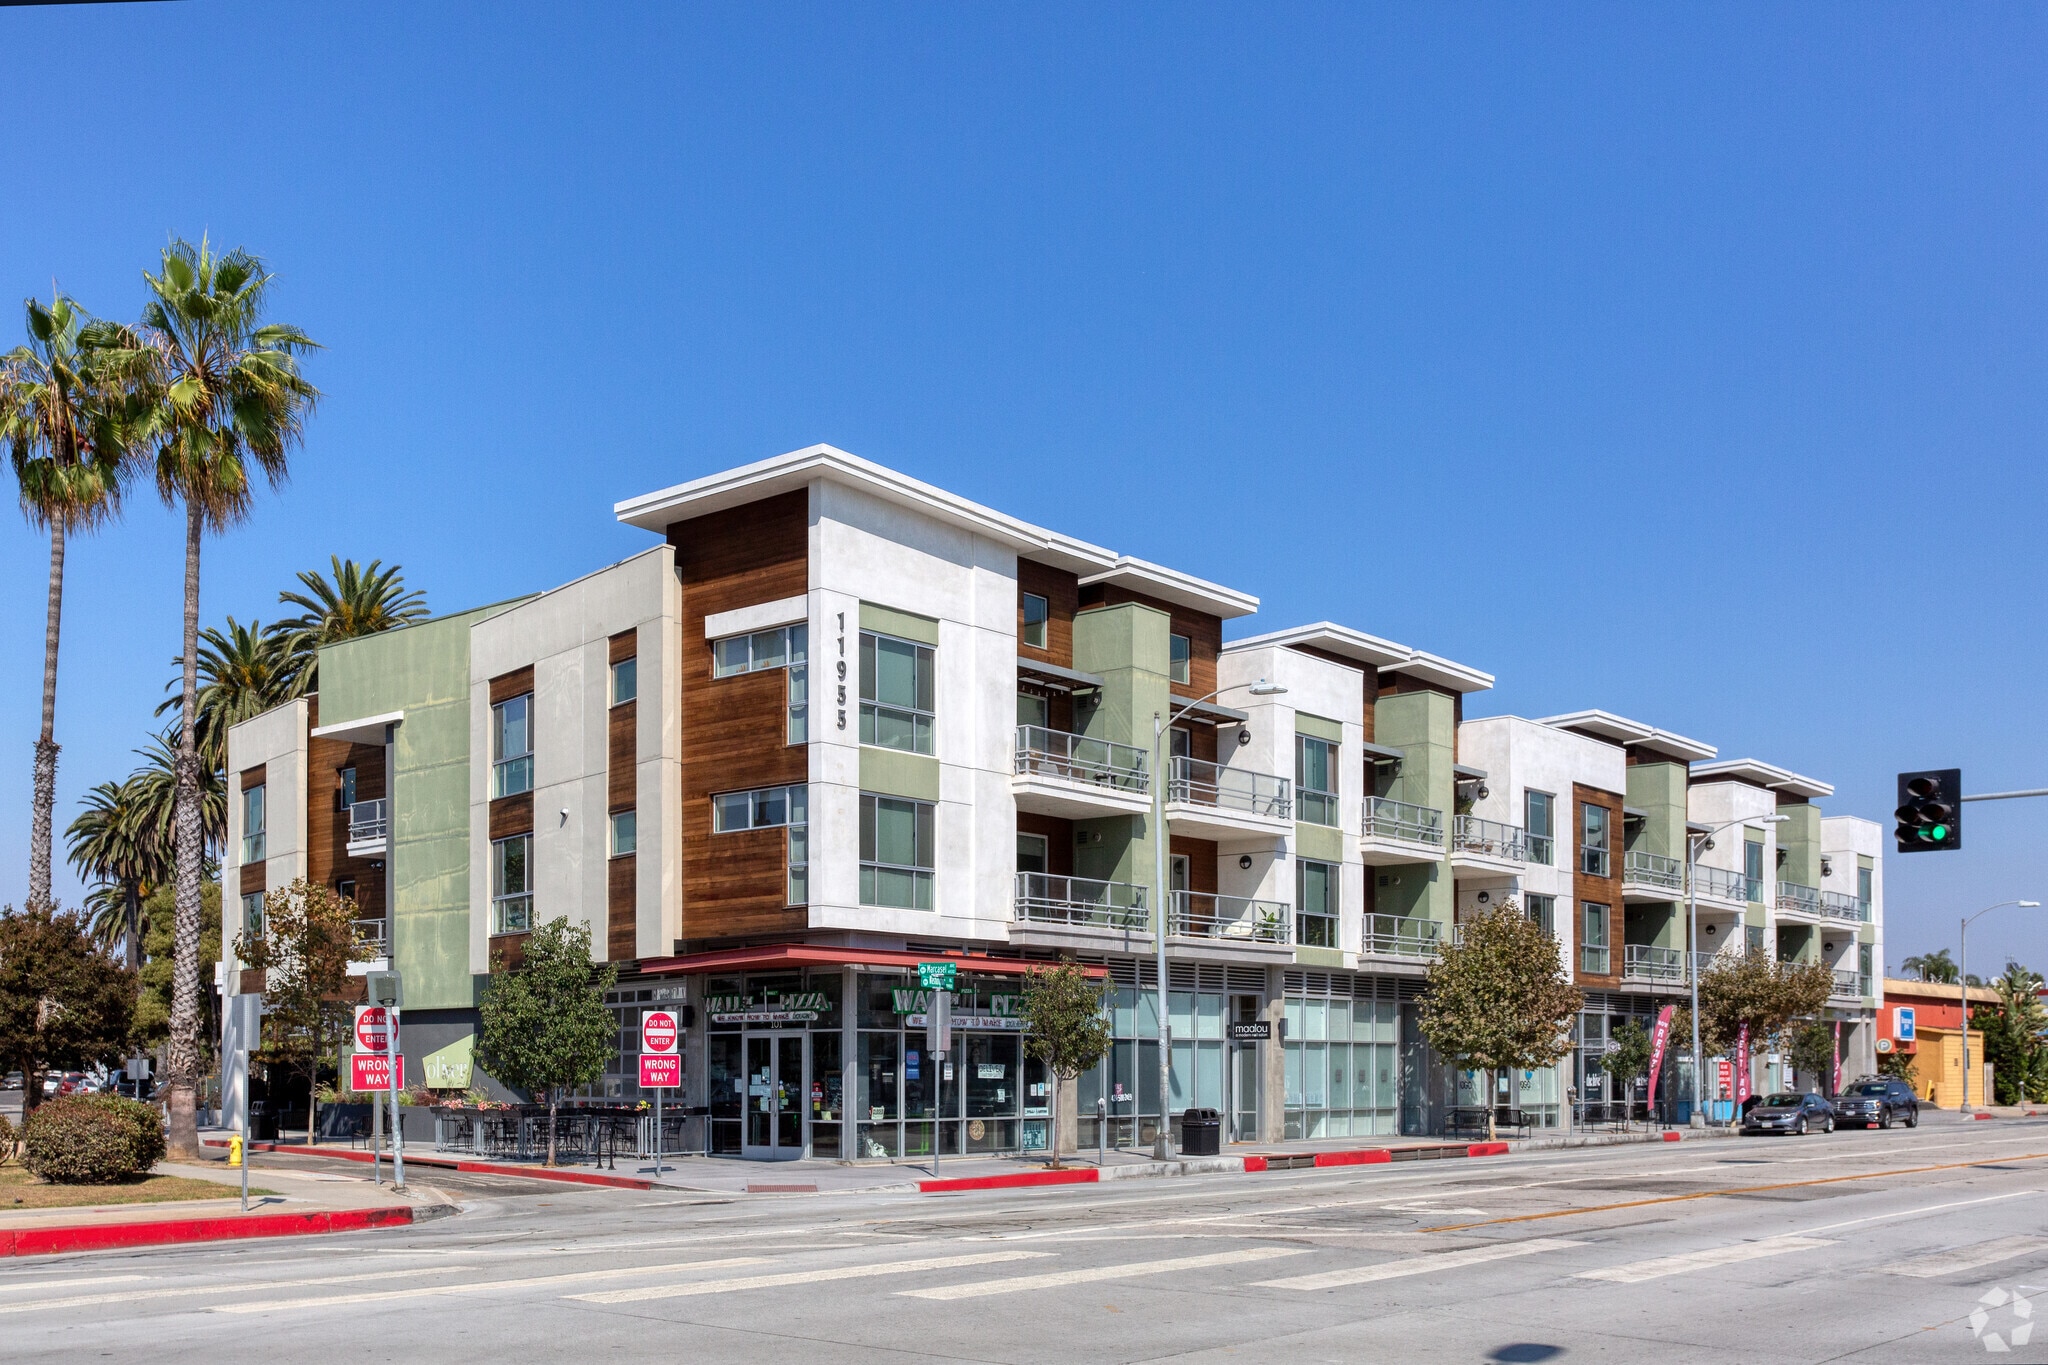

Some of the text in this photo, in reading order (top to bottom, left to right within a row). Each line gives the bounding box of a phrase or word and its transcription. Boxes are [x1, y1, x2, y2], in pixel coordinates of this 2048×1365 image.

[836, 611, 847, 731] 11955
[927, 964, 947, 974] Marcasel
[779, 992, 829, 1011] PIZZA
[991, 994, 1030, 1015] PIZZ
[363, 1015, 387, 1023] DO NO
[648, 1019, 672, 1027] DO NOT
[912, 1016, 923, 1025] WE
[1235, 1023, 1268, 1033] maalou
[365, 1035, 387, 1043] ENTE
[650, 1037, 670, 1045] ENTER
[1880, 1041, 1889, 1050] P
[358, 1060, 398, 1071] WRON
[426, 1055, 467, 1079] oliver
[644, 1060, 676, 1070] WRONG
[365, 1073, 390, 1085] WAY
[650, 1072, 669, 1082] WAY
